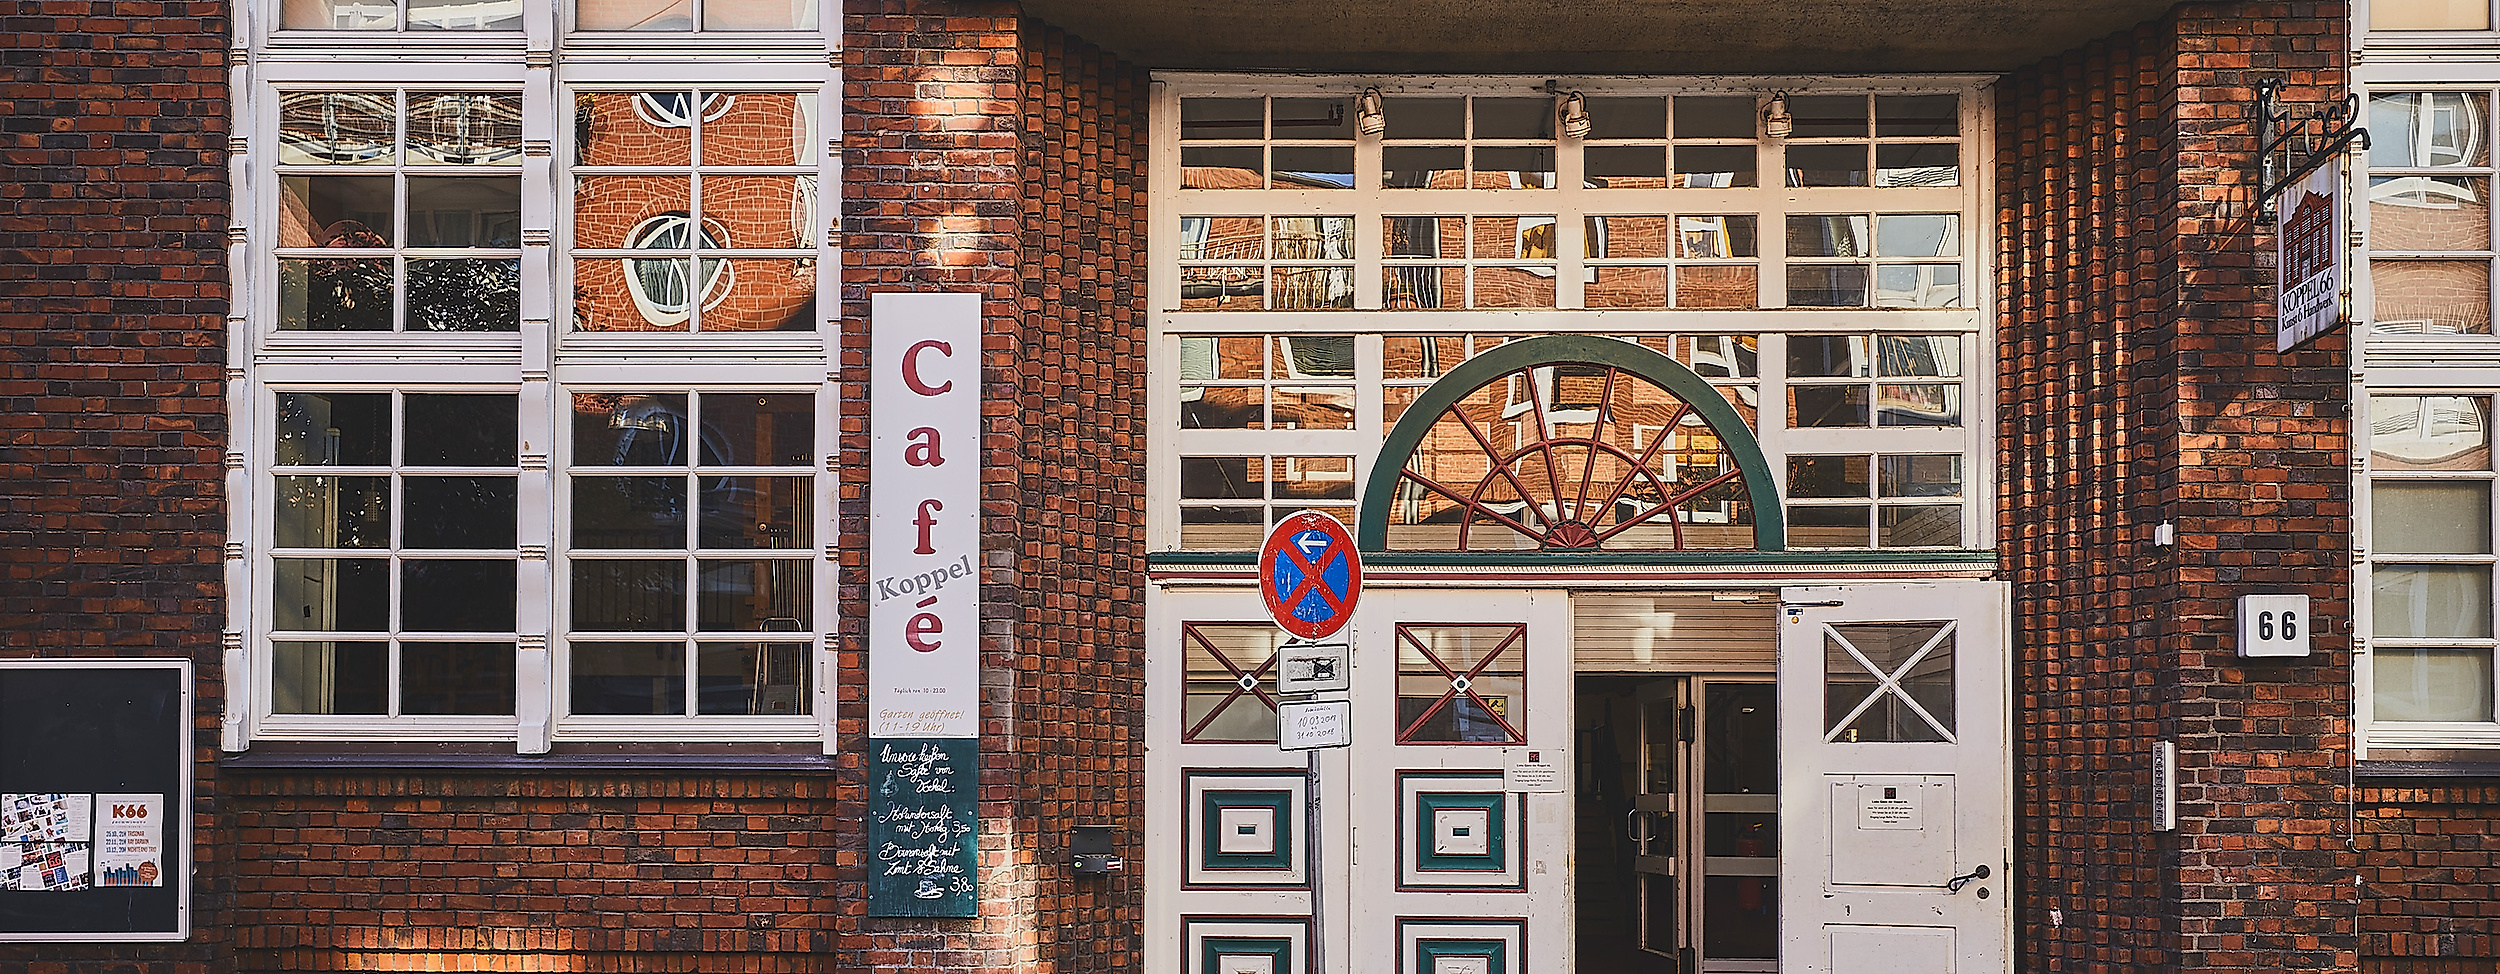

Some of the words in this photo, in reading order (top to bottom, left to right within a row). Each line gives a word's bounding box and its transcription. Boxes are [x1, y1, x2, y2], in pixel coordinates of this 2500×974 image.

[2282, 278, 2320, 316] KOPPEL
[2319, 268, 2334, 294] 66
[2282, 315, 2298, 332] Kunst
[2304, 291, 2334, 320] Handwerk
[901, 339, 953, 653] Café
[875, 554, 974, 601] Koppel
[2258, 610, 2297, 642] 66
[879, 708, 914, 721] Garten
[918, 709, 965, 723] geöffnet!
[934, 766, 955, 775] von
[112, 804, 147, 818] K66
[895, 821, 915, 833] mit
[911, 821, 949, 844] Honig
[951, 820, 971, 838] 3,50
[924, 858, 965, 876] Sahne
[949, 876, 975, 897] 3,80
